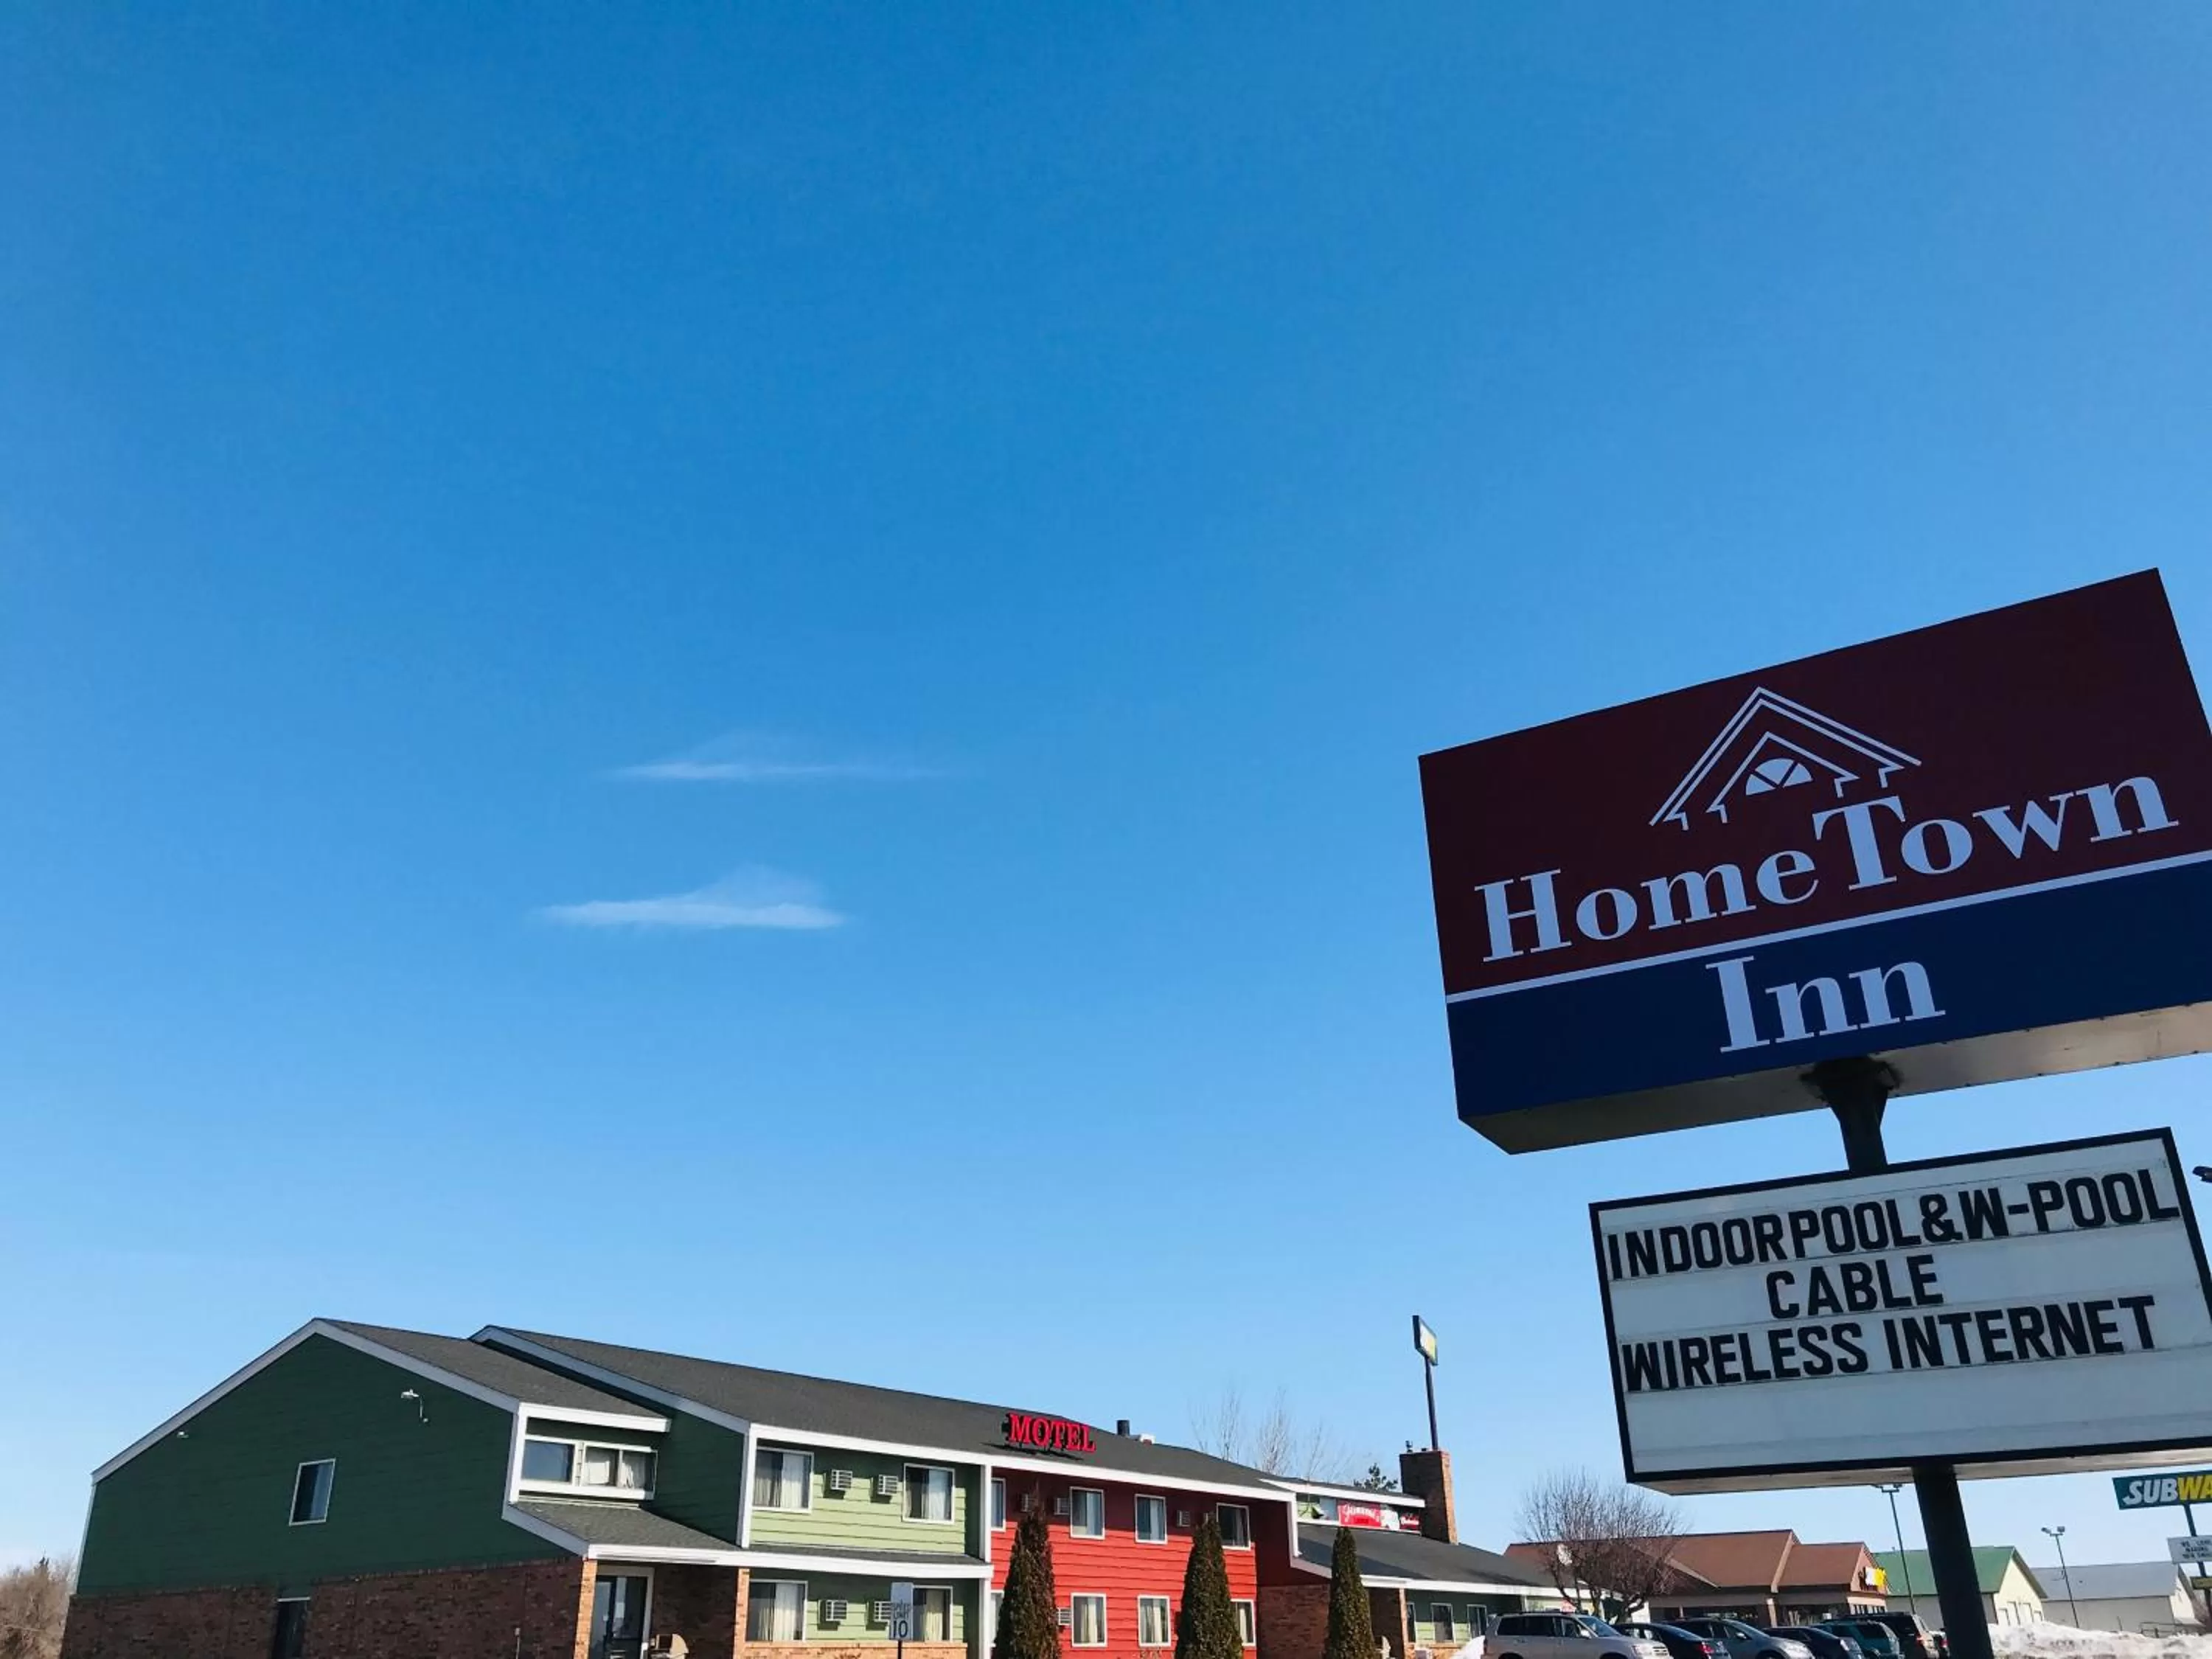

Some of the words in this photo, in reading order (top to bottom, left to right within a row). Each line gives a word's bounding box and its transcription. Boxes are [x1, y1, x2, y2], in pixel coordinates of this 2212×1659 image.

[1475, 775, 2179, 962] HomeTown
[1705, 956, 1947, 1053] Inn
[1766, 1254, 1944, 1320] CABLE
[1622, 1322, 1869, 1392] WIRELESS
[1882, 1295, 2156, 1369] INTERNET
[1009, 1412, 1097, 1453] MOTEL
[894, 1620, 908, 1638] 10
